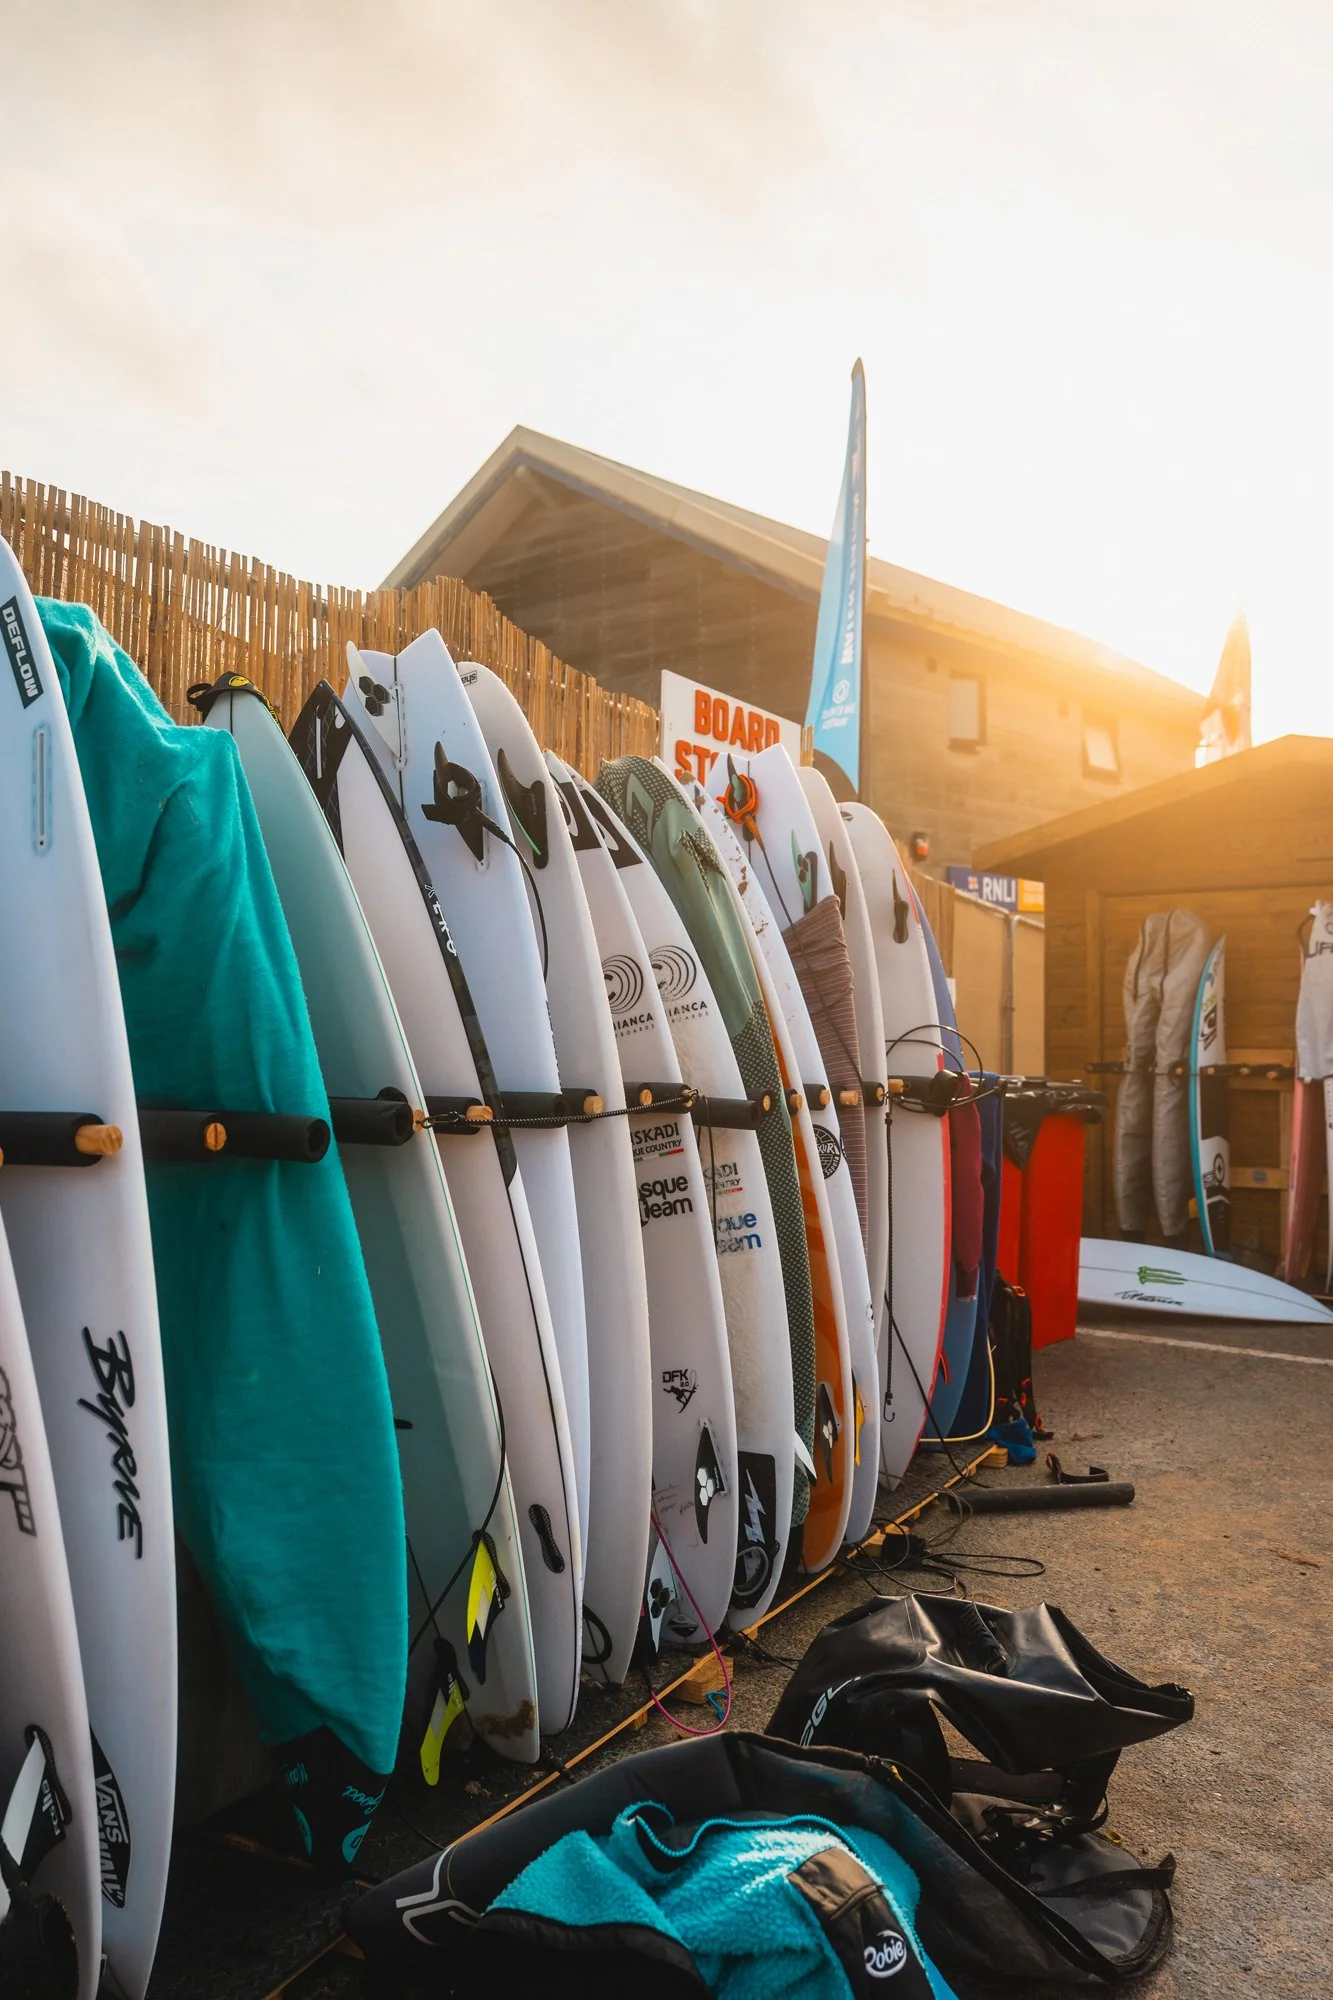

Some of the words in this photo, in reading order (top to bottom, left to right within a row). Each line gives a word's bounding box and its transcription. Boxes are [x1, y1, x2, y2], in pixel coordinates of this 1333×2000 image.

[2, 606, 39, 698] DEFLOW
[694, 689, 780, 754] BOARD
[982, 876, 1016, 903] RNLI
[665, 1000, 708, 1017] IANCA
[615, 1023, 655, 1038] BOARDS
[645, 1138, 682, 1154] COUNTRY
[639, 1175, 689, 1201] sque
[662, 1368, 689, 1383] DFK
[96, 1772, 129, 1844] VANS
[864, 1938, 905, 1970] Robie
